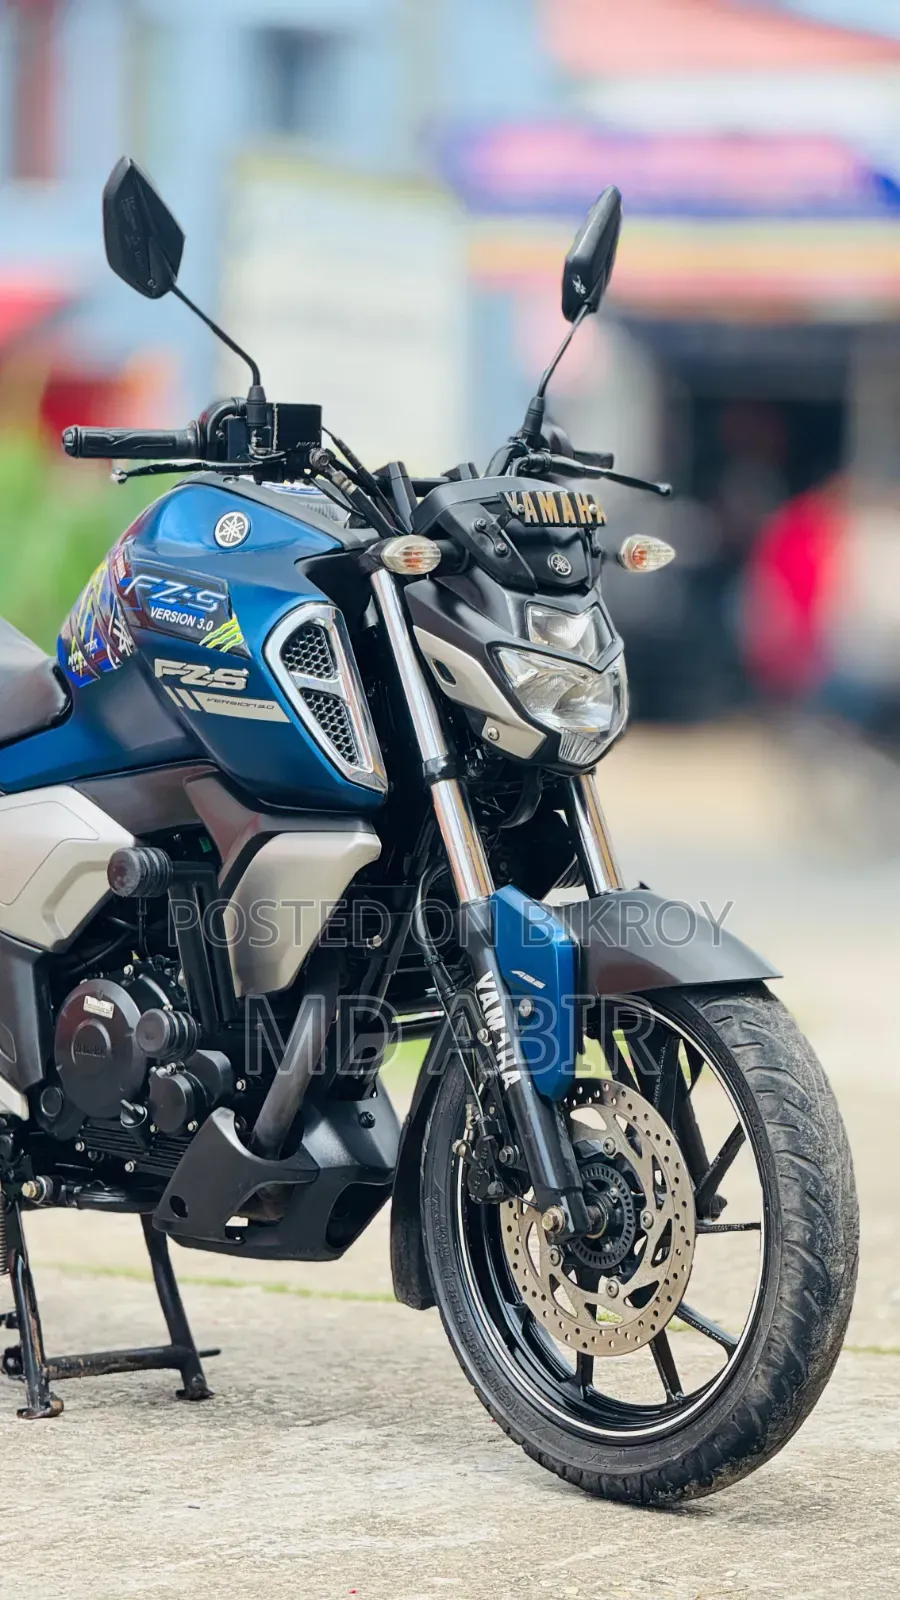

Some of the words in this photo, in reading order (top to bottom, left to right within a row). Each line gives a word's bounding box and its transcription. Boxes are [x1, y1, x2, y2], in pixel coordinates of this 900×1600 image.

[503, 491, 607, 523] YAMAHA
[150, 606, 195, 626] VERSION
[196, 617, 214, 632] 3.0
[206, 697, 256, 708] VERSION
